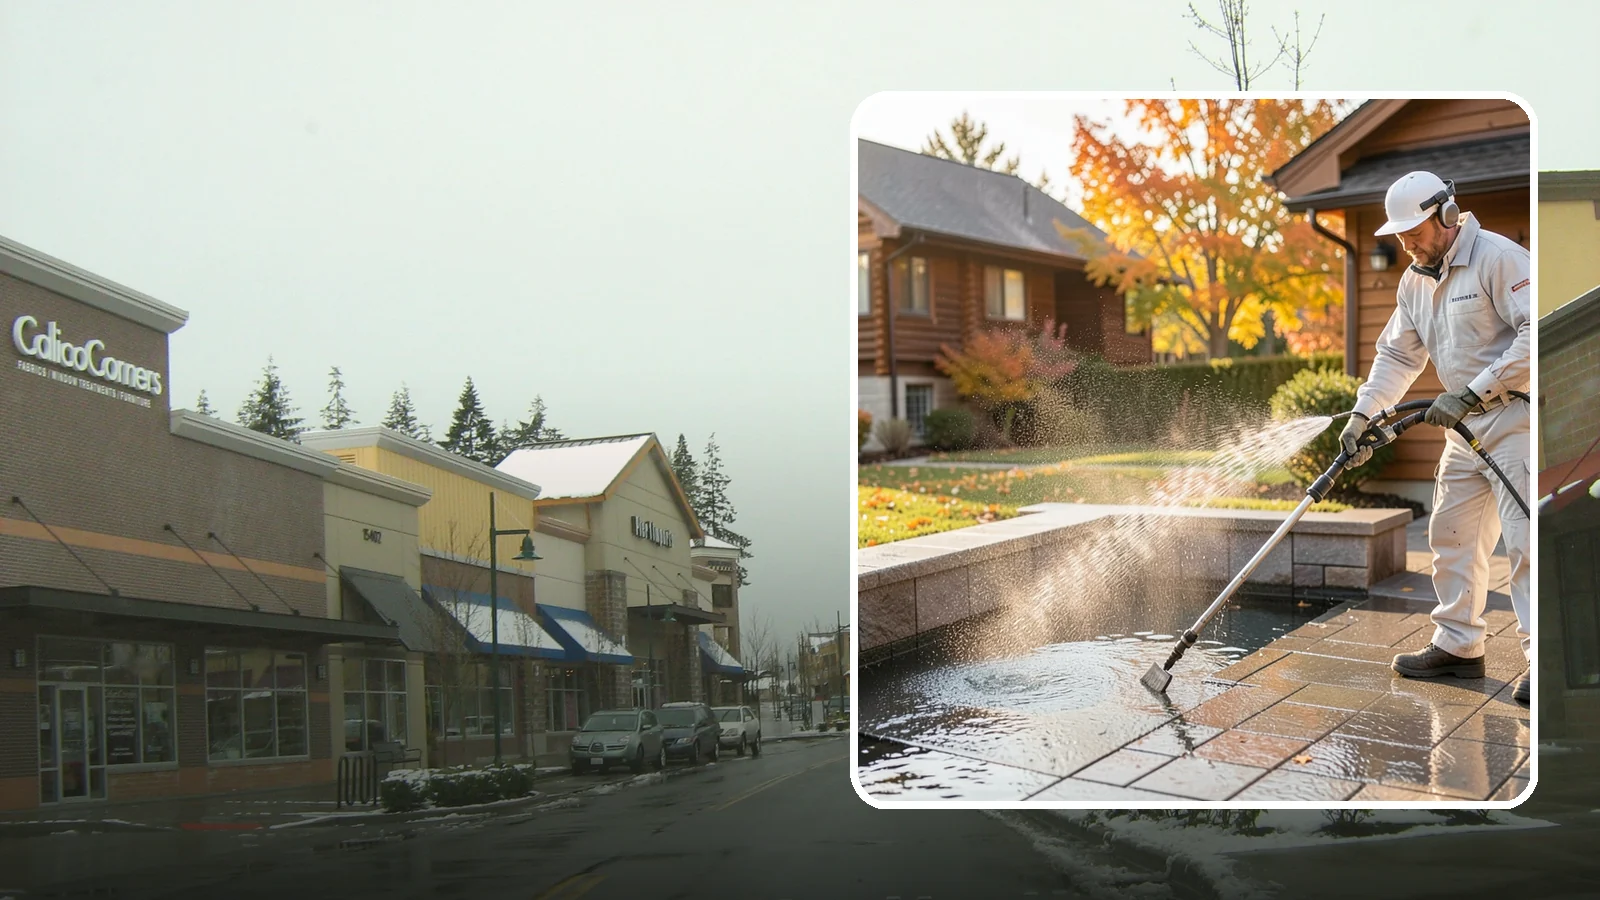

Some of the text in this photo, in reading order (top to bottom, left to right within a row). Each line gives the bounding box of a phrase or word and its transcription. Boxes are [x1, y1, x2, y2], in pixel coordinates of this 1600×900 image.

[17, 360, 47, 377] FABRICS
[51, 370, 78, 386] WINDOW
[78, 378, 117, 398] TREATMENTS
[120, 391, 151, 409] FURNITURE
